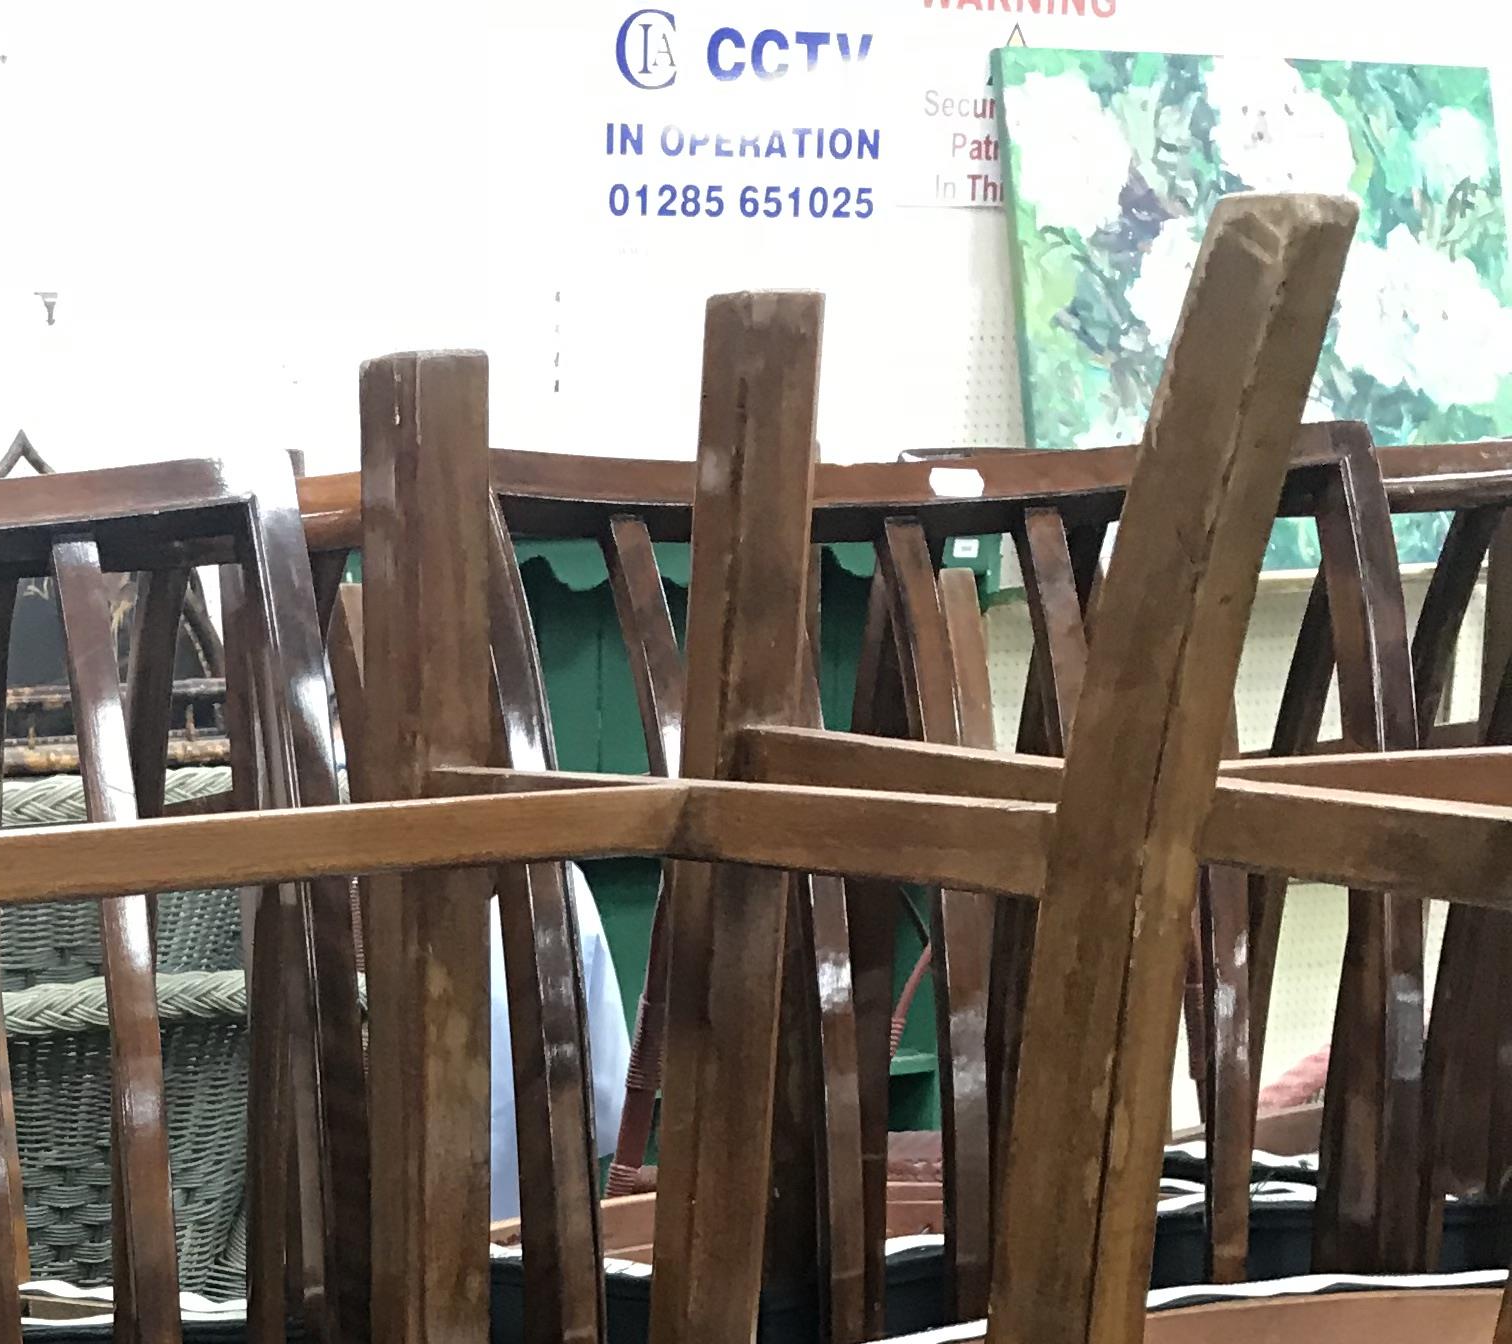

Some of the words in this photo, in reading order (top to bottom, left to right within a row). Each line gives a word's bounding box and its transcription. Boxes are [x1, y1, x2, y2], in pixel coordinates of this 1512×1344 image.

[707, 27, 873, 82] CCTV
[606, 122, 643, 156] IN
[660, 124, 880, 160] OPERATION
[609, 183, 724, 217] 01285
[739, 185, 874, 219] 651025
